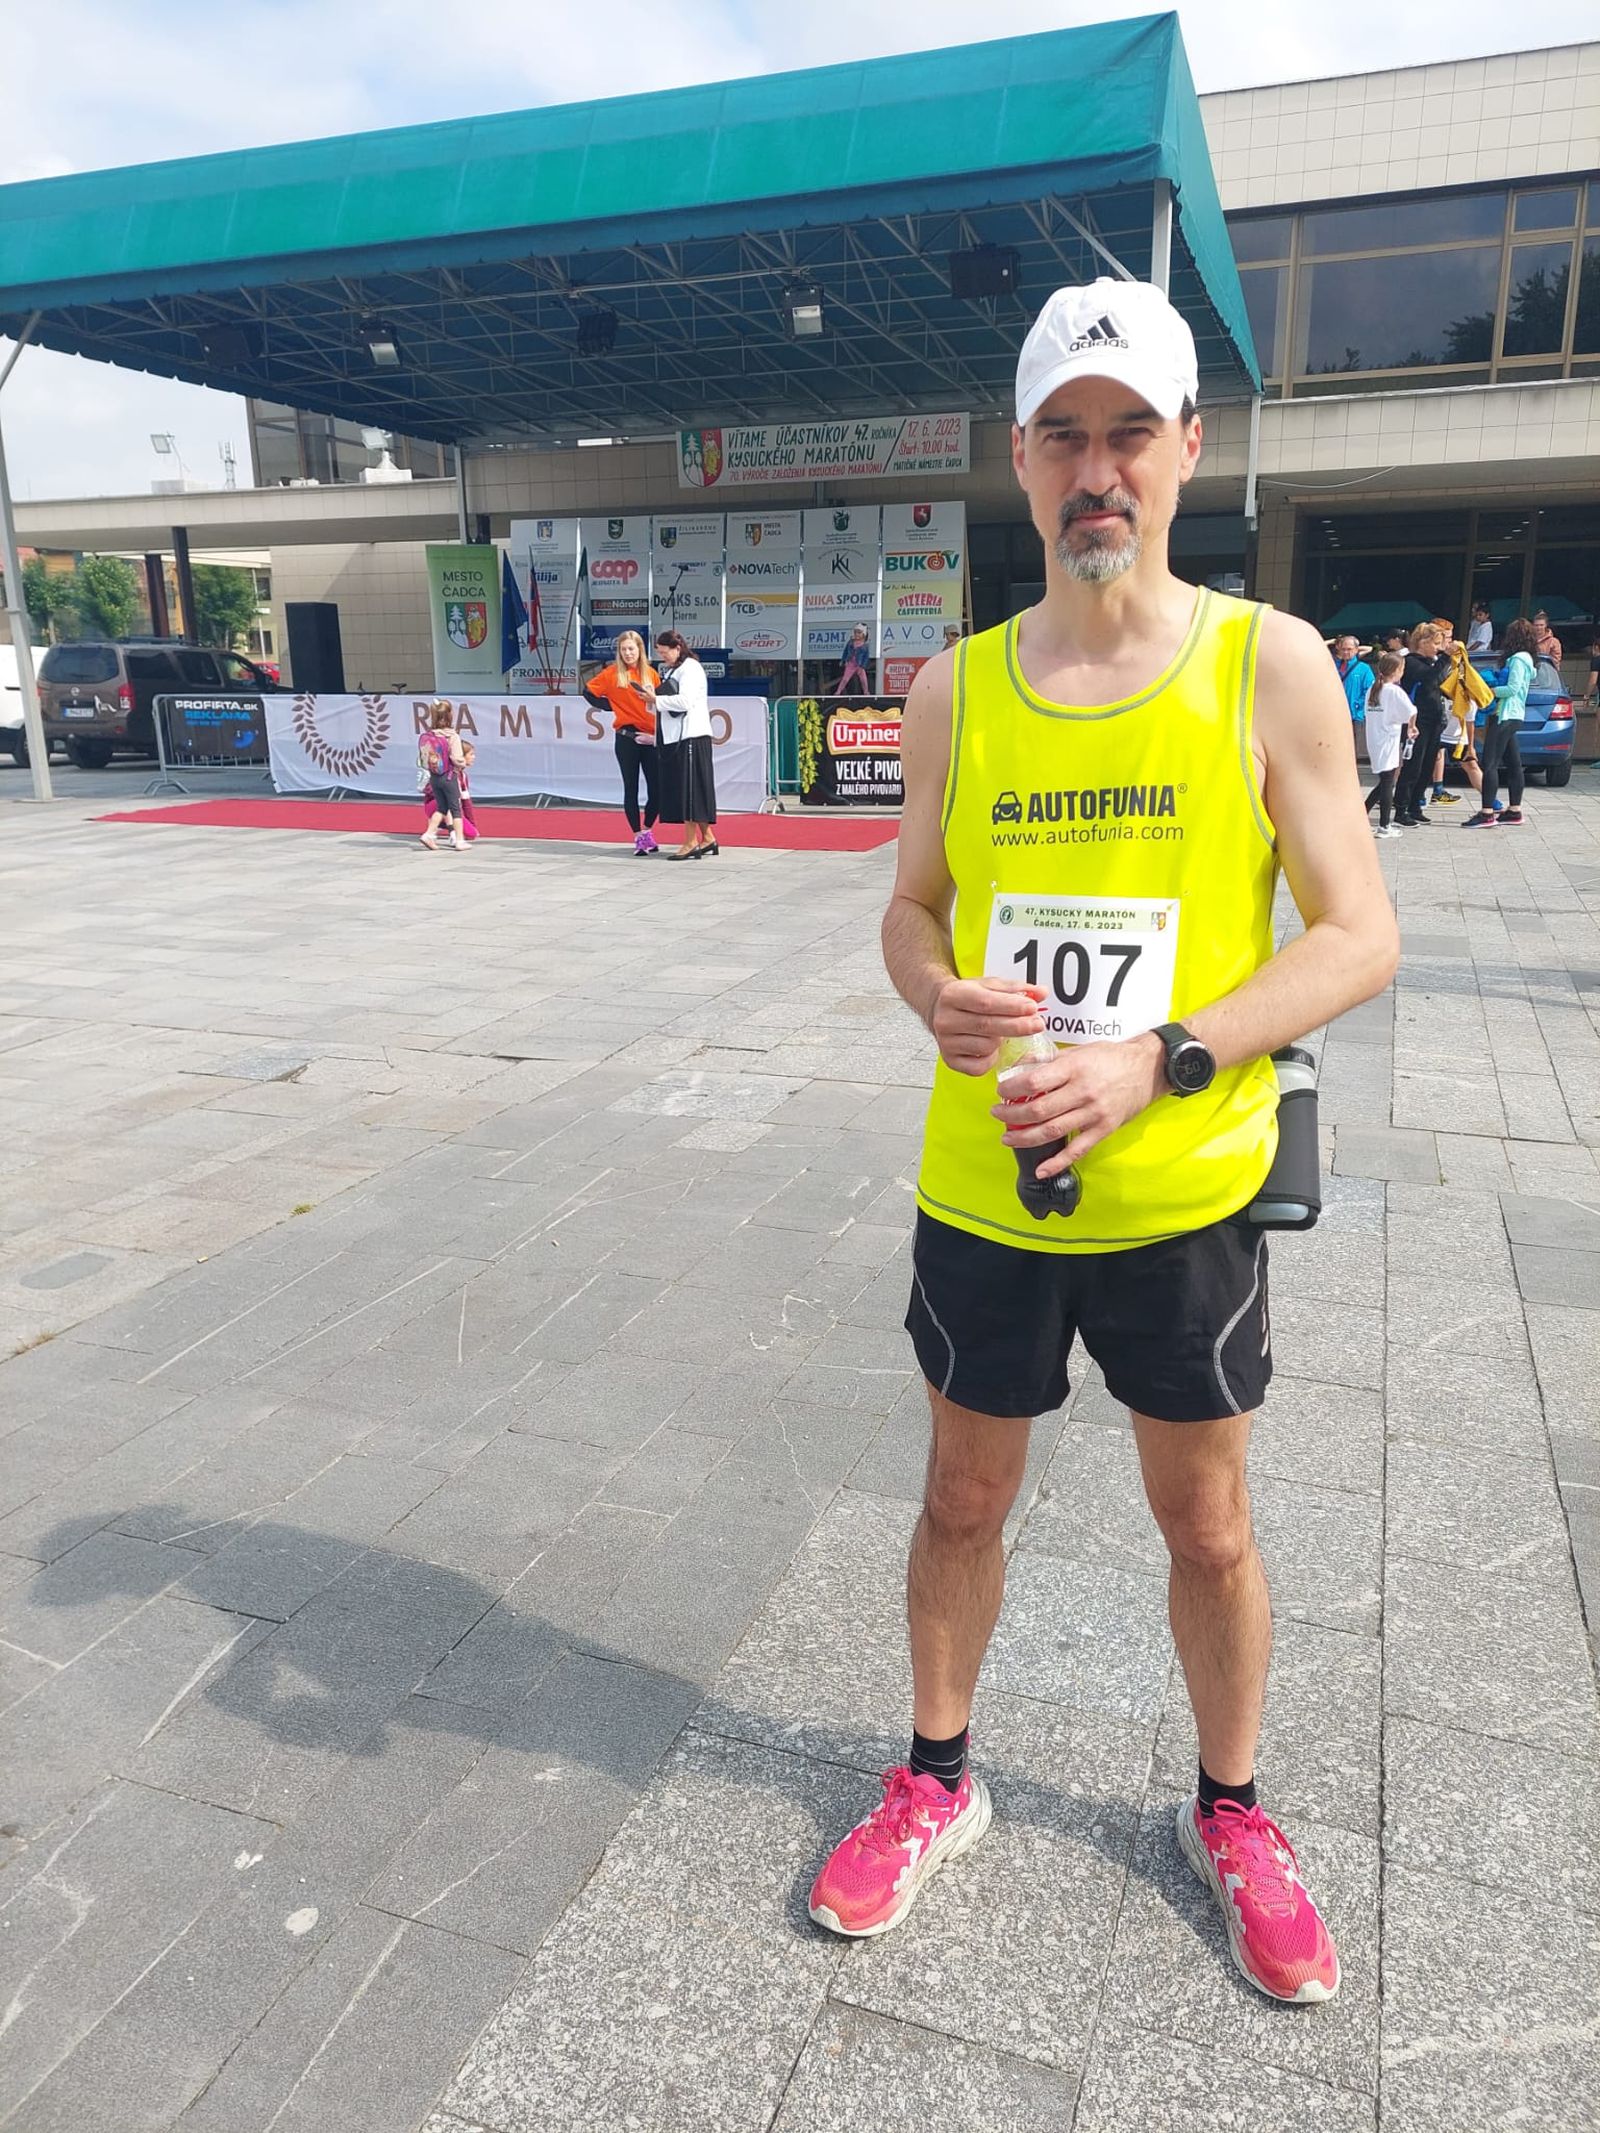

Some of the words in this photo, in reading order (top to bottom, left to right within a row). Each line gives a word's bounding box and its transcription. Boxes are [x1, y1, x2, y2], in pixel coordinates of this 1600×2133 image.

[1070, 338, 1129, 352] adidas
[908, 420, 919, 438] 17.
[922, 420, 930, 437] 6.
[935, 416, 961, 436] 2023
[728, 429, 767, 448] VÍTAME
[776, 422, 850, 446] ÚČASTNÍKOV
[854, 424, 869, 442] 47.
[728, 447, 796, 468] KYSUCKÉHO
[804, 442, 876, 464] MARATÓNU
[443, 571, 484, 582] MESTO
[590, 560, 638, 585] coop
[442, 584, 486, 597] ČADCA
[694, 595, 720, 606] s.r.o.
[805, 594, 834, 606] NIKA
[836, 593, 875, 604] SPORT
[897, 593, 942, 607] PIZZERIA
[736, 604, 756, 614] TCB
[808, 632, 846, 642] PAJMI
[740, 640, 784, 648] SPORT
[512, 668, 576, 678] FRONTINUS
[184, 710, 251, 720] REKLAMA
[836, 756, 872, 780] VEĽKÉ
[875, 760, 901, 780] PIVO
[836, 784, 841, 795] Z
[842, 782, 868, 795] MALÉHO
[992, 822, 1184, 847] www.autofunia.com
[1040, 907, 1081, 917] KYSUCKÝ
[1085, 908, 1136, 918] MARATÓN
[1034, 918, 1064, 929] Čadca,
[1014, 939, 1142, 1006] 107
[1044, 1015, 1122, 1036] NOVATech
